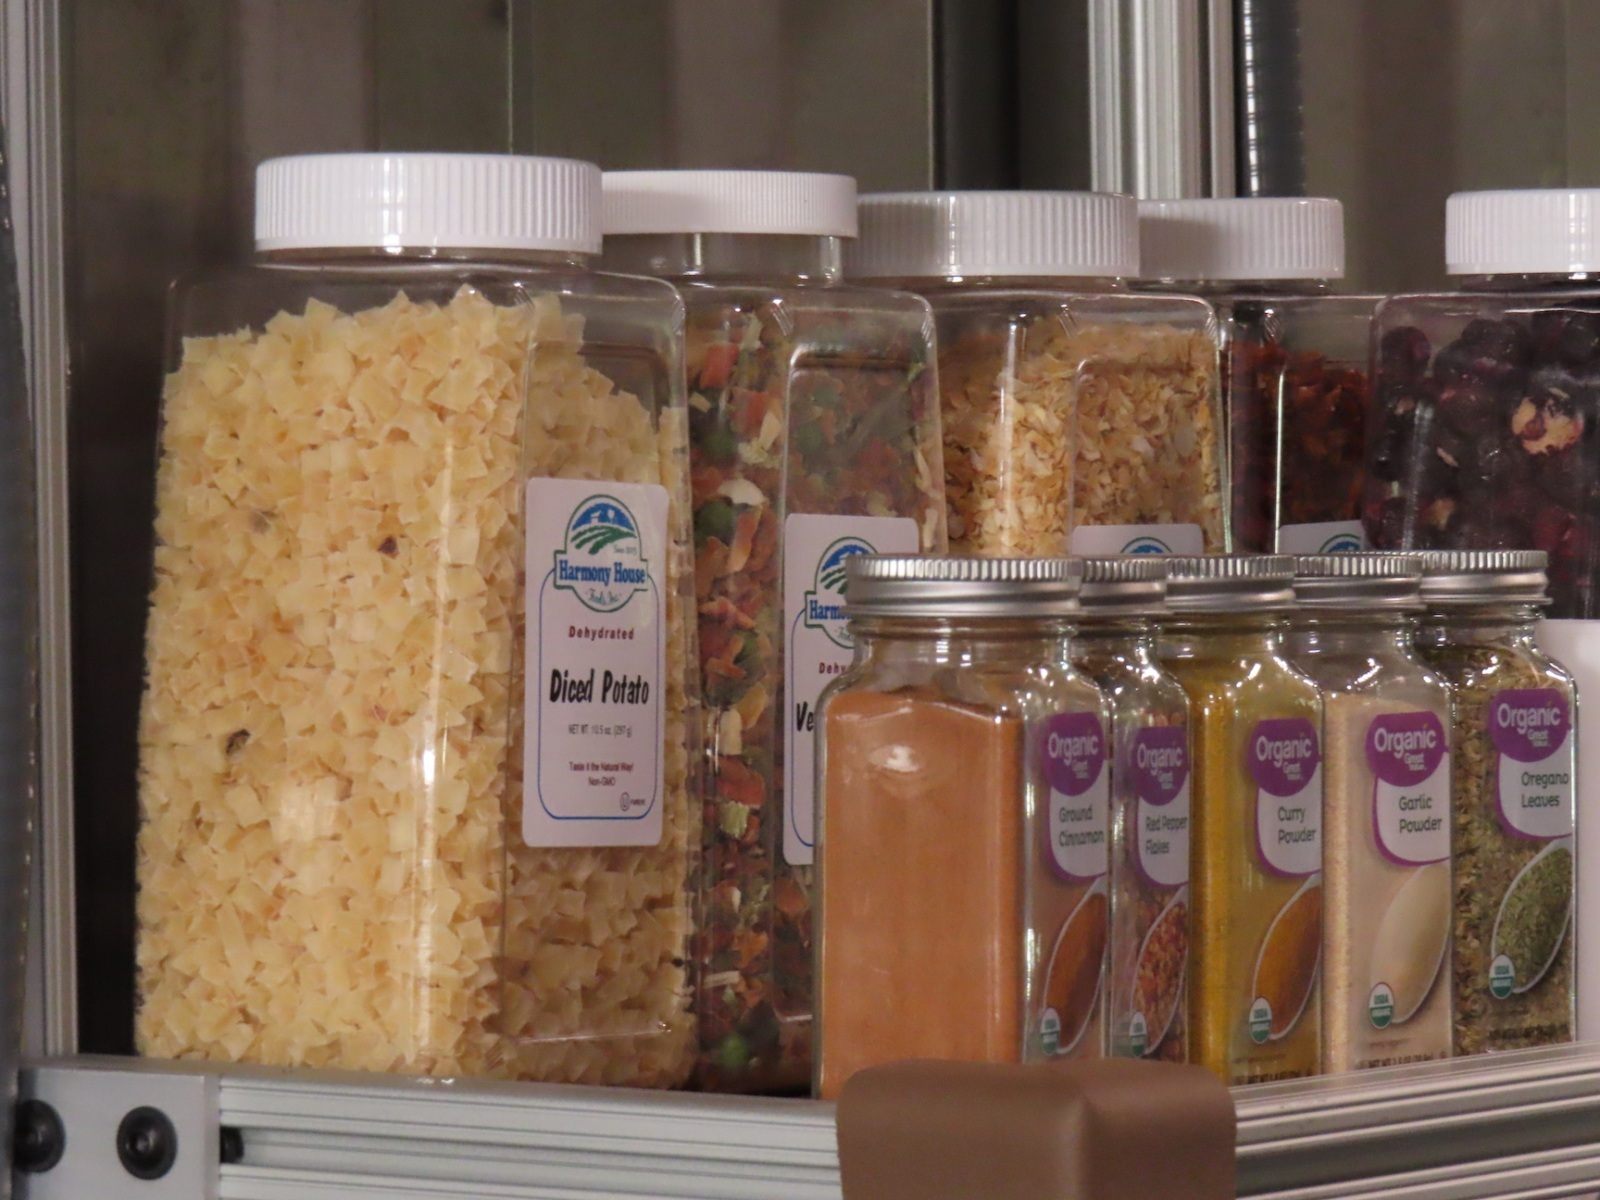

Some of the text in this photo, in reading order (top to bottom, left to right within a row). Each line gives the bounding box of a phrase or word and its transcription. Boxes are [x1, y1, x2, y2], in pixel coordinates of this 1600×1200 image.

[559, 560, 645, 587] Harmony House
[809, 600, 852, 620] Harm
[568, 626, 635, 641] Dehydrated
[550, 668, 649, 705] Diced Potato
[1497, 703, 1561, 735] Organic
[1048, 732, 1099, 766] Organic
[1256, 735, 1312, 768] Organic
[1374, 727, 1437, 759] Organic
[1137, 743, 1183, 776] Organic
[1521, 771, 1569, 789] Oregano
[1399, 794, 1432, 811] Garlic
[1521, 793, 1560, 808] Leaves
[1059, 805, 1093, 823] Ground
[1277, 805, 1305, 824] Curry
[1399, 817, 1442, 834] Powder
[1059, 829, 1104, 847] Cinnamon
[1277, 827, 1317, 844] Powder
